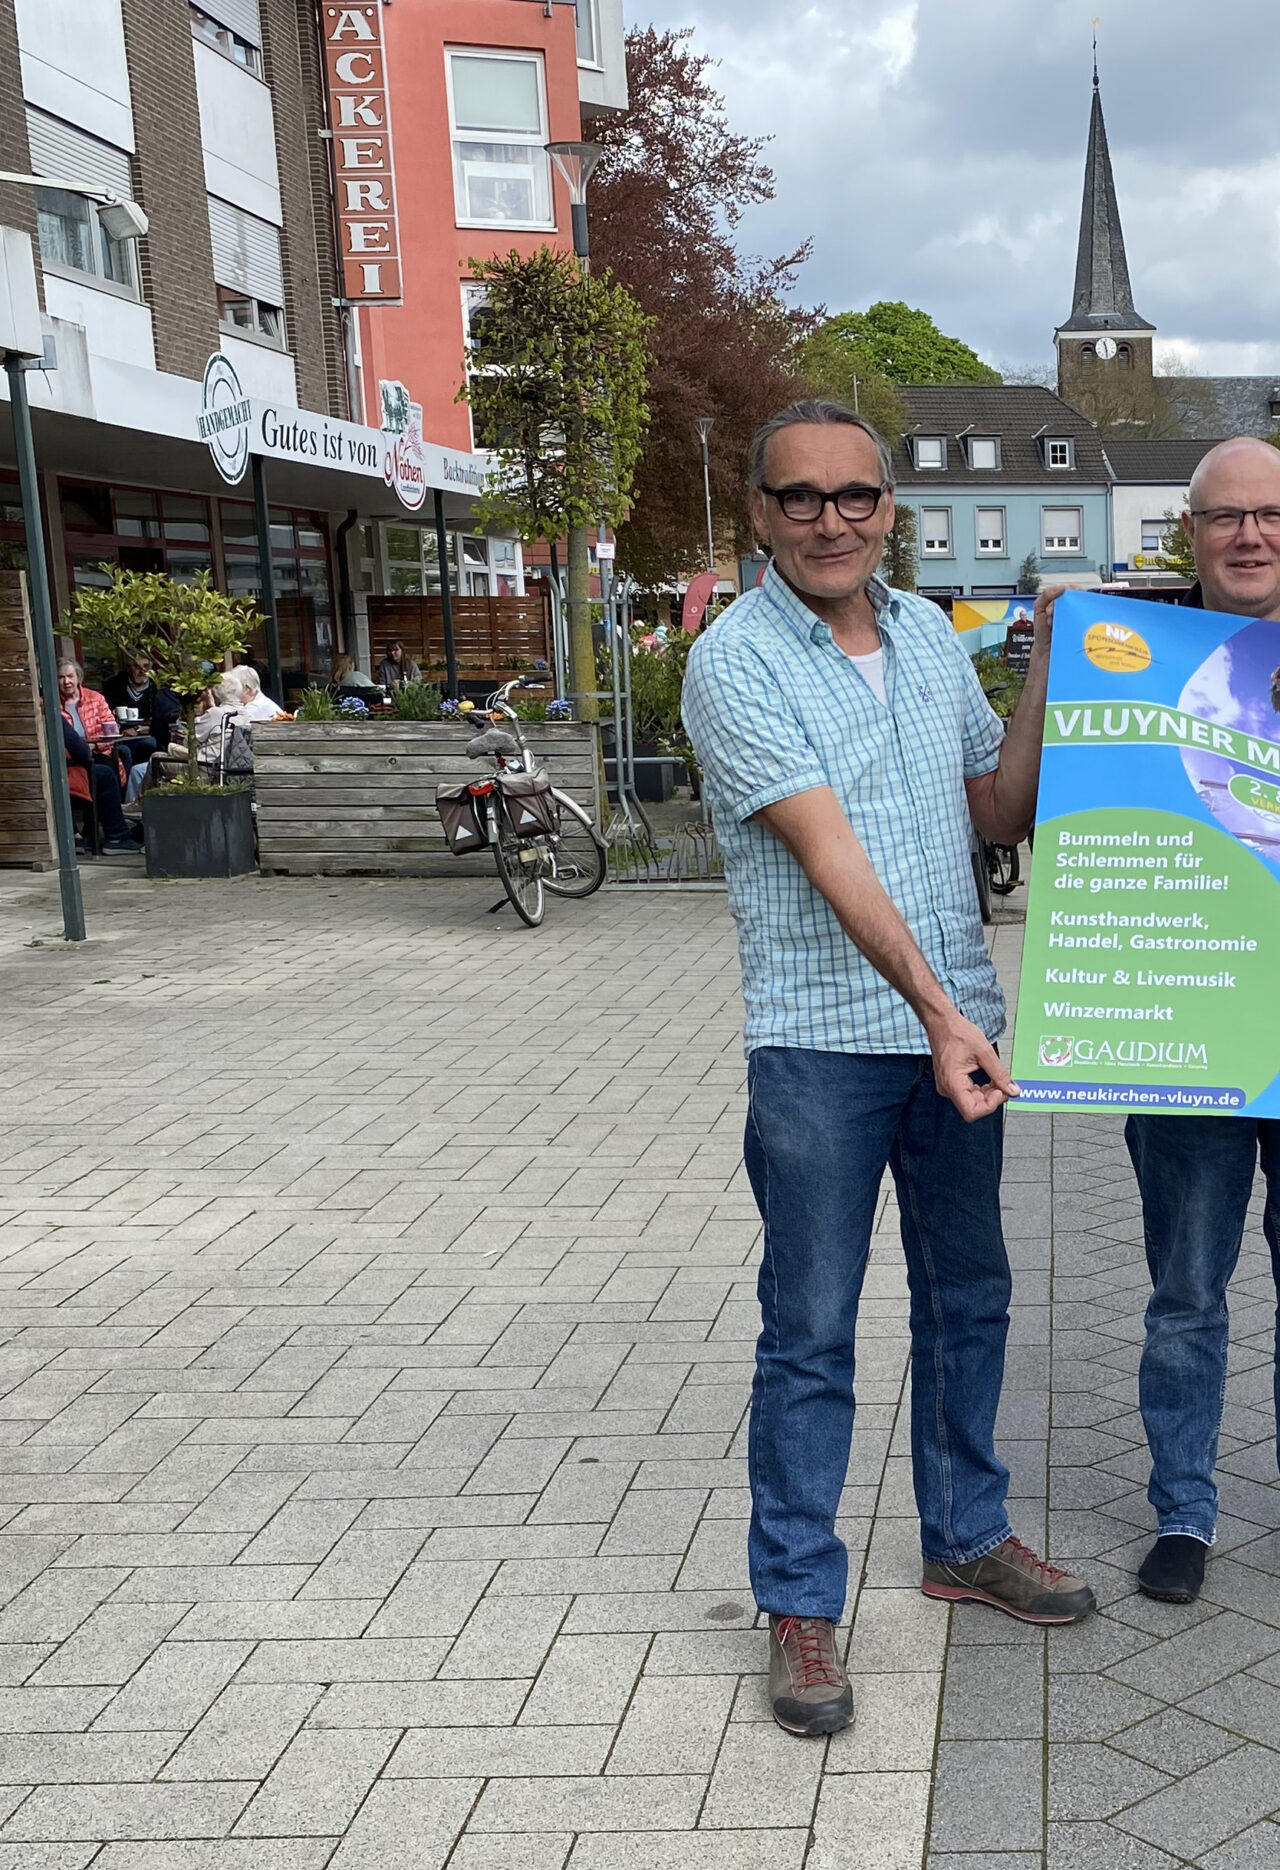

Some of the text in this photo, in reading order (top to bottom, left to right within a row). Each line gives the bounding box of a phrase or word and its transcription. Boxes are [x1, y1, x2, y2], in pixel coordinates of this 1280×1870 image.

[199, 399, 252, 438] HANDGEMACHT
[261, 408, 378, 468] Gutes ist von
[1105, 623, 1133, 642] NV
[1053, 708, 1237, 755] VLUYNER
[1249, 781, 1268, 798] 2.
[1058, 831, 1194, 847] Bummeln und
[1056, 853, 1203, 868] Schlemmen für
[1054, 873, 1229, 893] die ganze Familie!
[1050, 911, 1209, 931] Kunsthandwerk,
[1048, 933, 1258, 952] Handel, Gastronomie
[1045, 968, 1236, 988] Kultur & Livemusik
[1043, 1002, 1174, 1021] Winzermarkt
[1074, 1039, 1208, 1065] GAUDIUM
[1018, 1086, 1240, 1108] www.neukirchen-vluyn.de
